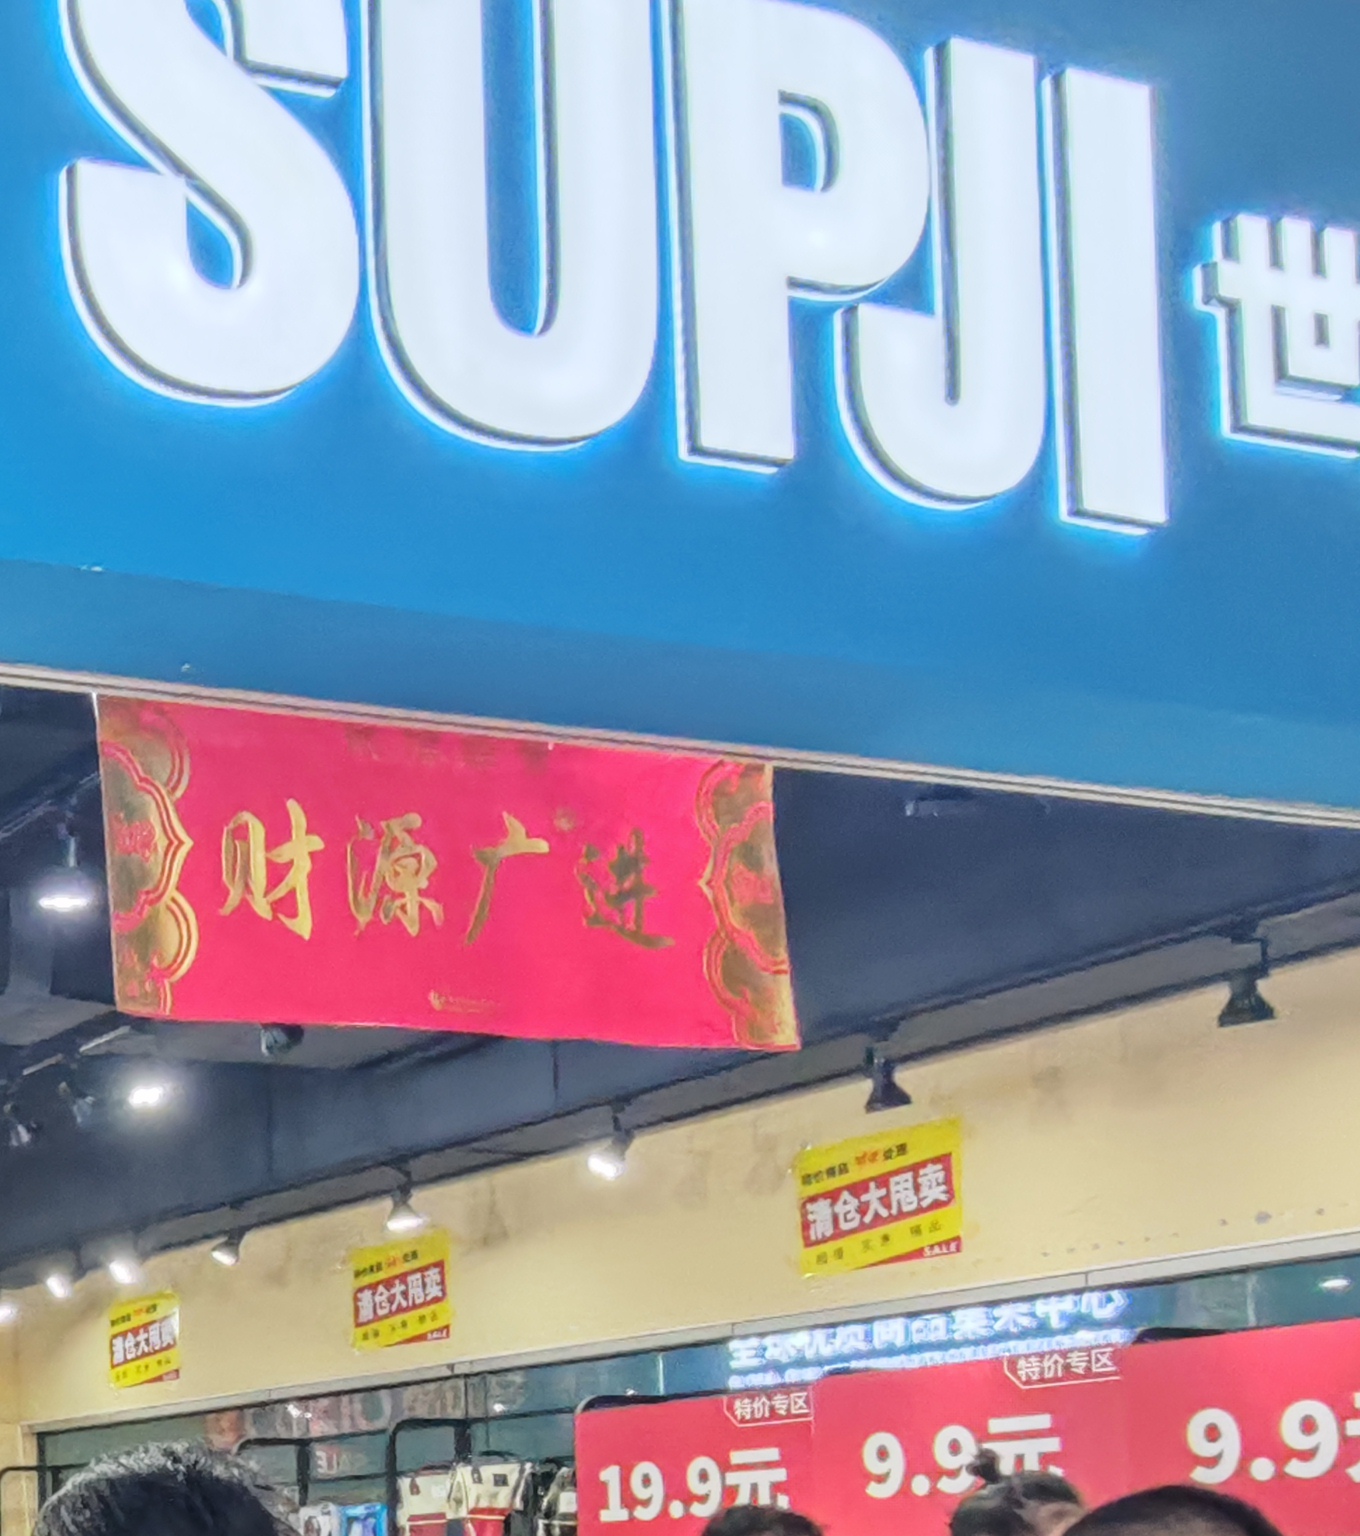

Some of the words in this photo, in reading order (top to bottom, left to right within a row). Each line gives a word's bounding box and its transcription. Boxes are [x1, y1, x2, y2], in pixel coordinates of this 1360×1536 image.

[60, 0, 1173, 535] SUPJI
[218, 798, 676, 949] 财源广进
[805, 1163, 951, 1242] 清仓大甩卖
[356, 1266, 444, 1323] 清仓大甩卖
[1016, 1348, 1117, 1382] 特价专区
[734, 1390, 809, 1422] 特价专区
[598, 1447, 791, 1523] 19.9元
[860, 1412, 1065, 1499] 9.9元
